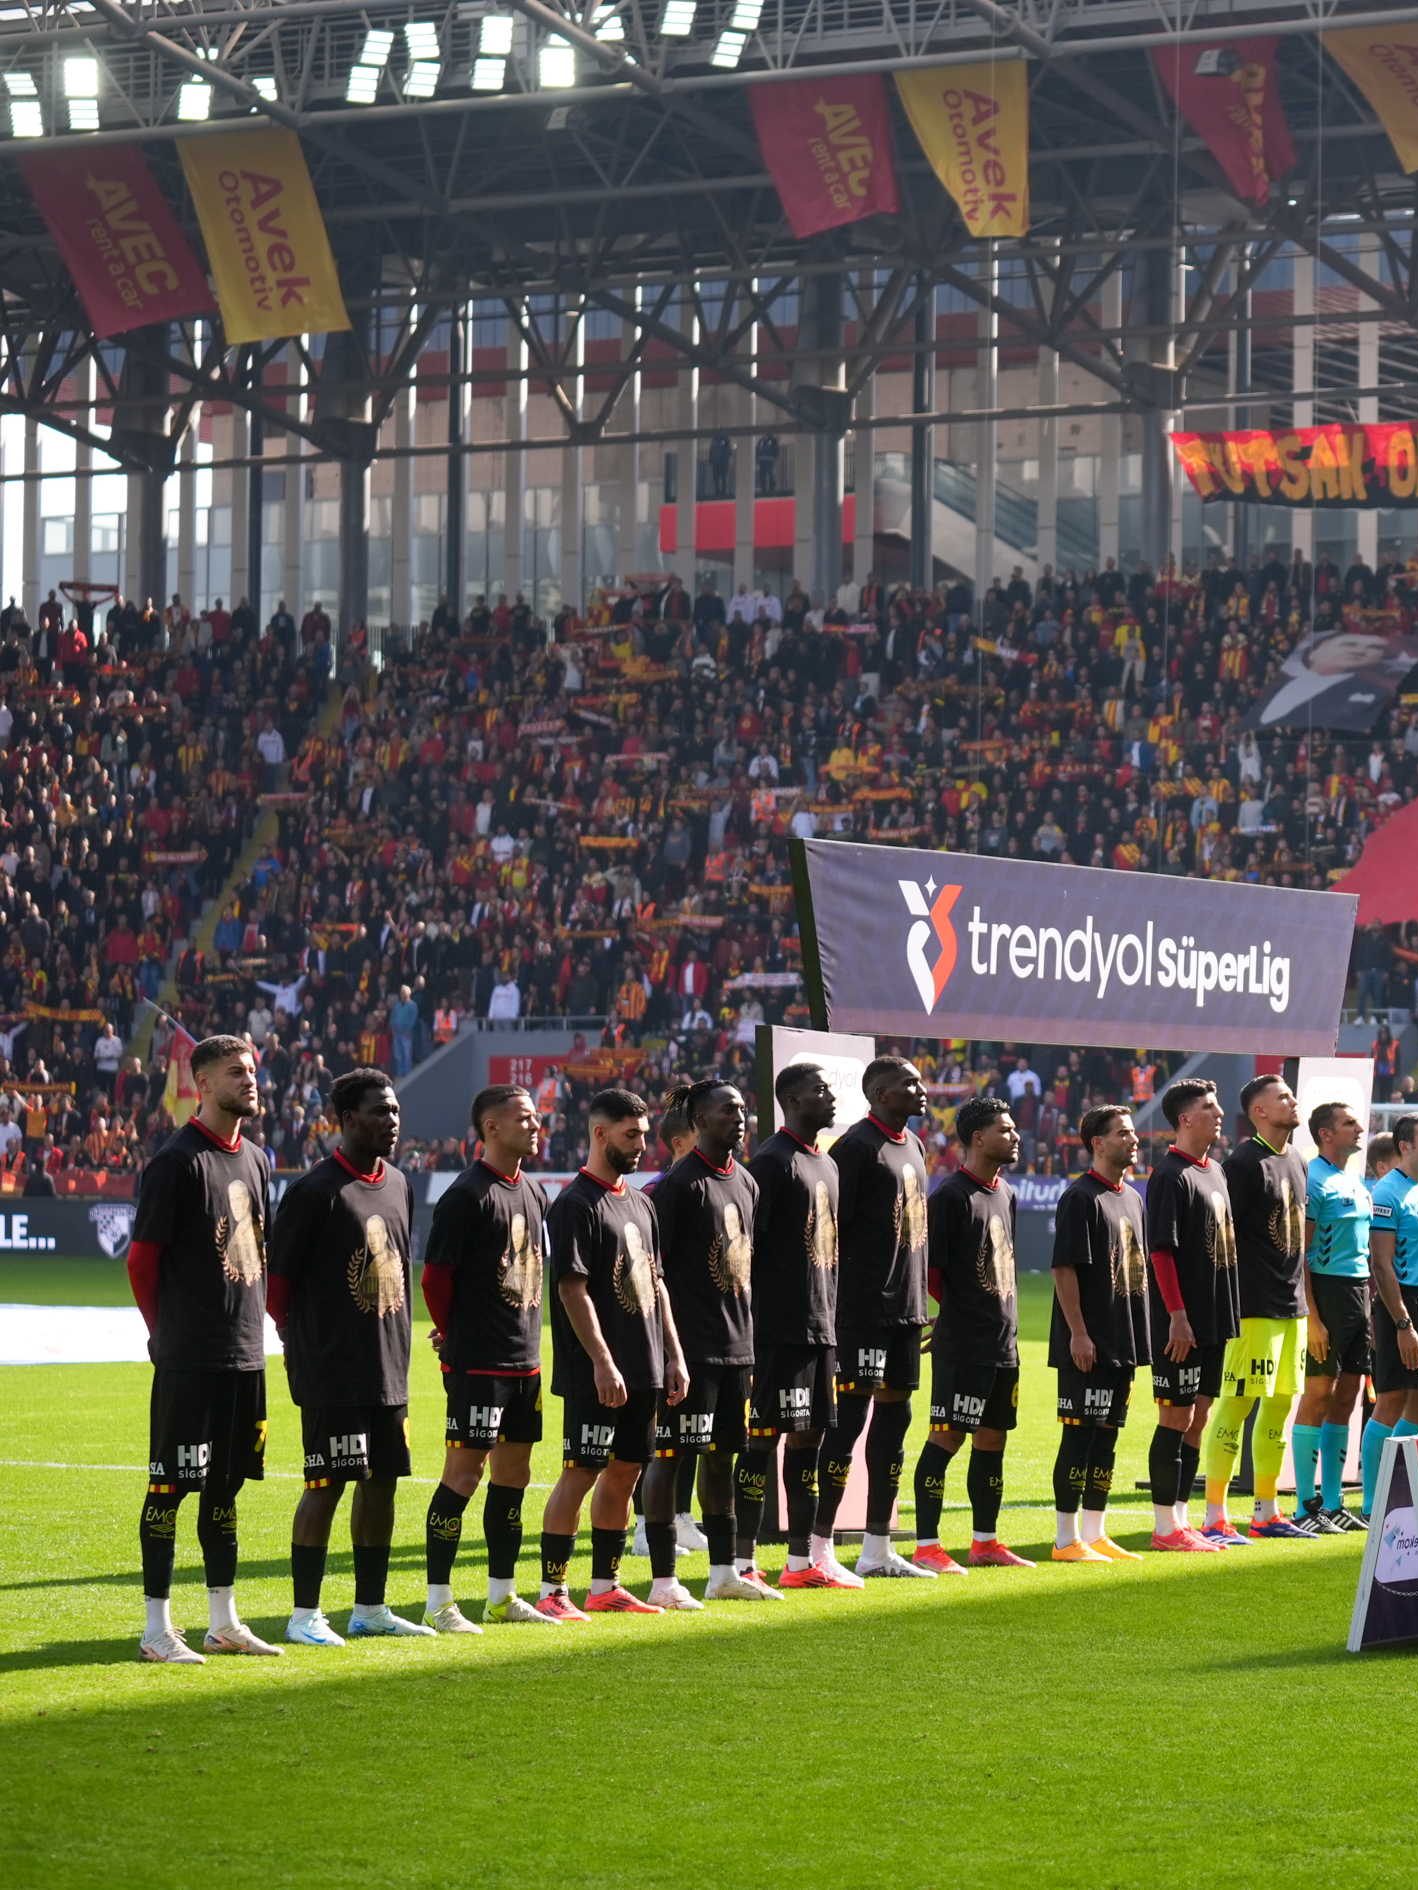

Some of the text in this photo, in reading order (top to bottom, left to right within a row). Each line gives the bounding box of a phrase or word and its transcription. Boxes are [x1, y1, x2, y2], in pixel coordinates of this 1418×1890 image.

[808, 137, 851, 209] rent a car
[942, 88, 985, 222] Otomotiv
[962, 88, 1017, 221] Avek
[85, 218, 143, 309] rent a car
[93, 172, 180, 296] AVEC
[218, 169, 273, 311] Otomotiv
[240, 168, 312, 309] Avek
[968, 906, 1290, 1013] trendyol süperLig
[829, 1066, 858, 1091] dyol
[1373, 1206, 1392, 1216] UTEST
[779, 1388, 811, 1409] HDI
[1178, 1366, 1201, 1386] HD
[679, 1413, 714, 1434] HDI
[781, 1408, 810, 1419] SİGORTA
[331, 1456, 368, 1468] SİGORT
